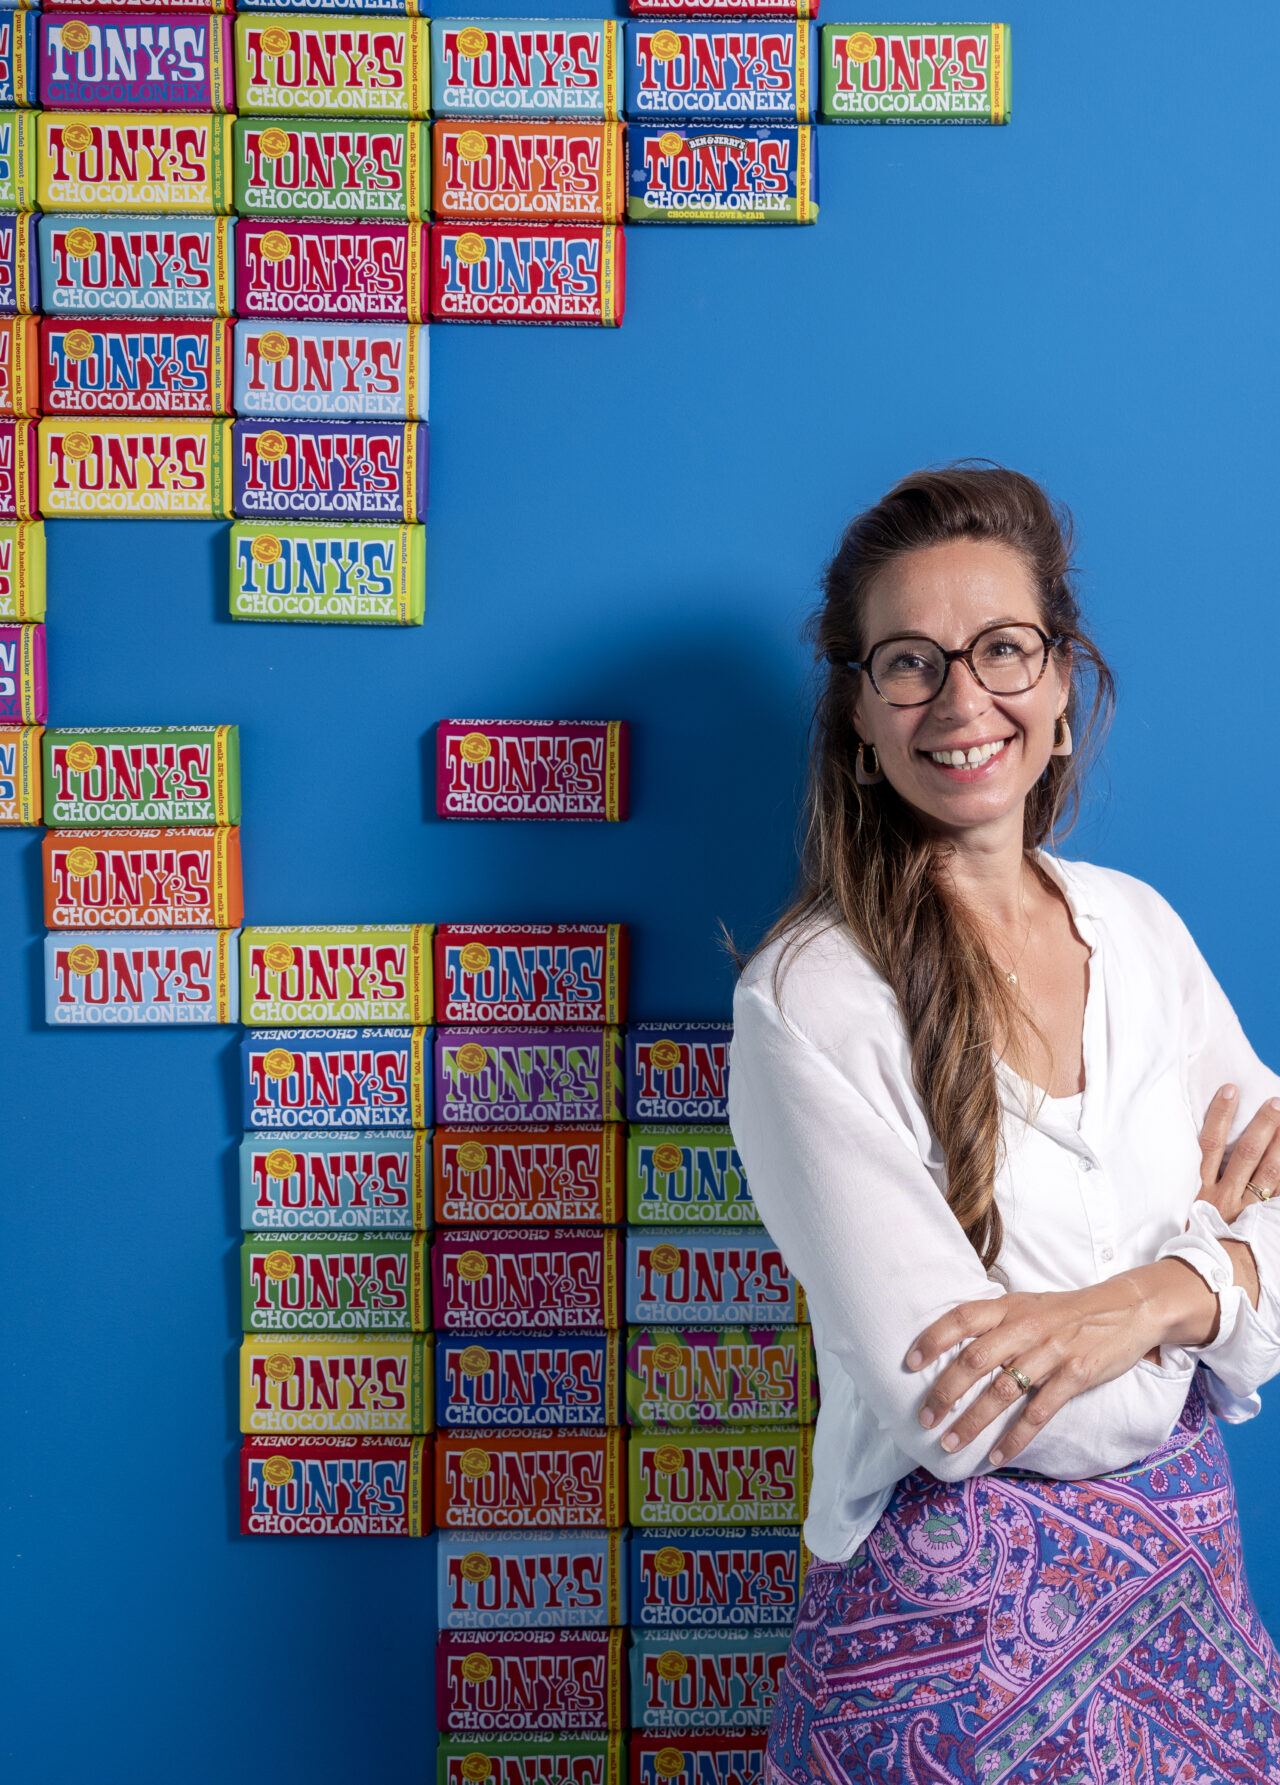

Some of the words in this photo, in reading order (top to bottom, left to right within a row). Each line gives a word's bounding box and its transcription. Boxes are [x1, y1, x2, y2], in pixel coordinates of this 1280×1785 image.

[245, 29, 407, 89] TONY'S
[636, 32, 795, 92] TONY'S
[833, 34, 989, 93] TONY'S
[245, 131, 404, 190] TONY'S
[442, 133, 601, 193] TONY'S
[644, 137, 789, 193] TONY'S
[217, 236, 225, 280] pennywafel
[246, 234, 405, 294] TONY'S
[441, 236, 600, 296] TONY'S
[48, 332, 210, 391] TONY'S
[242, 433, 401, 492] TONY'S
[237, 537, 396, 596] TONY'S
[51, 743, 213, 802] TONY'S
[446, 735, 605, 794] TONY'S
[445, 944, 604, 1003] TONY'S
[250, 1049, 409, 1108] TONY'S
[250, 1251, 409, 1310] TONY'S
[445, 1347, 604, 1406] TONY'S
[248, 1457, 407, 1516] TONY'S
[446, 1449, 605, 1508] TONY'S
[447, 1654, 606, 1711] TONY'S
